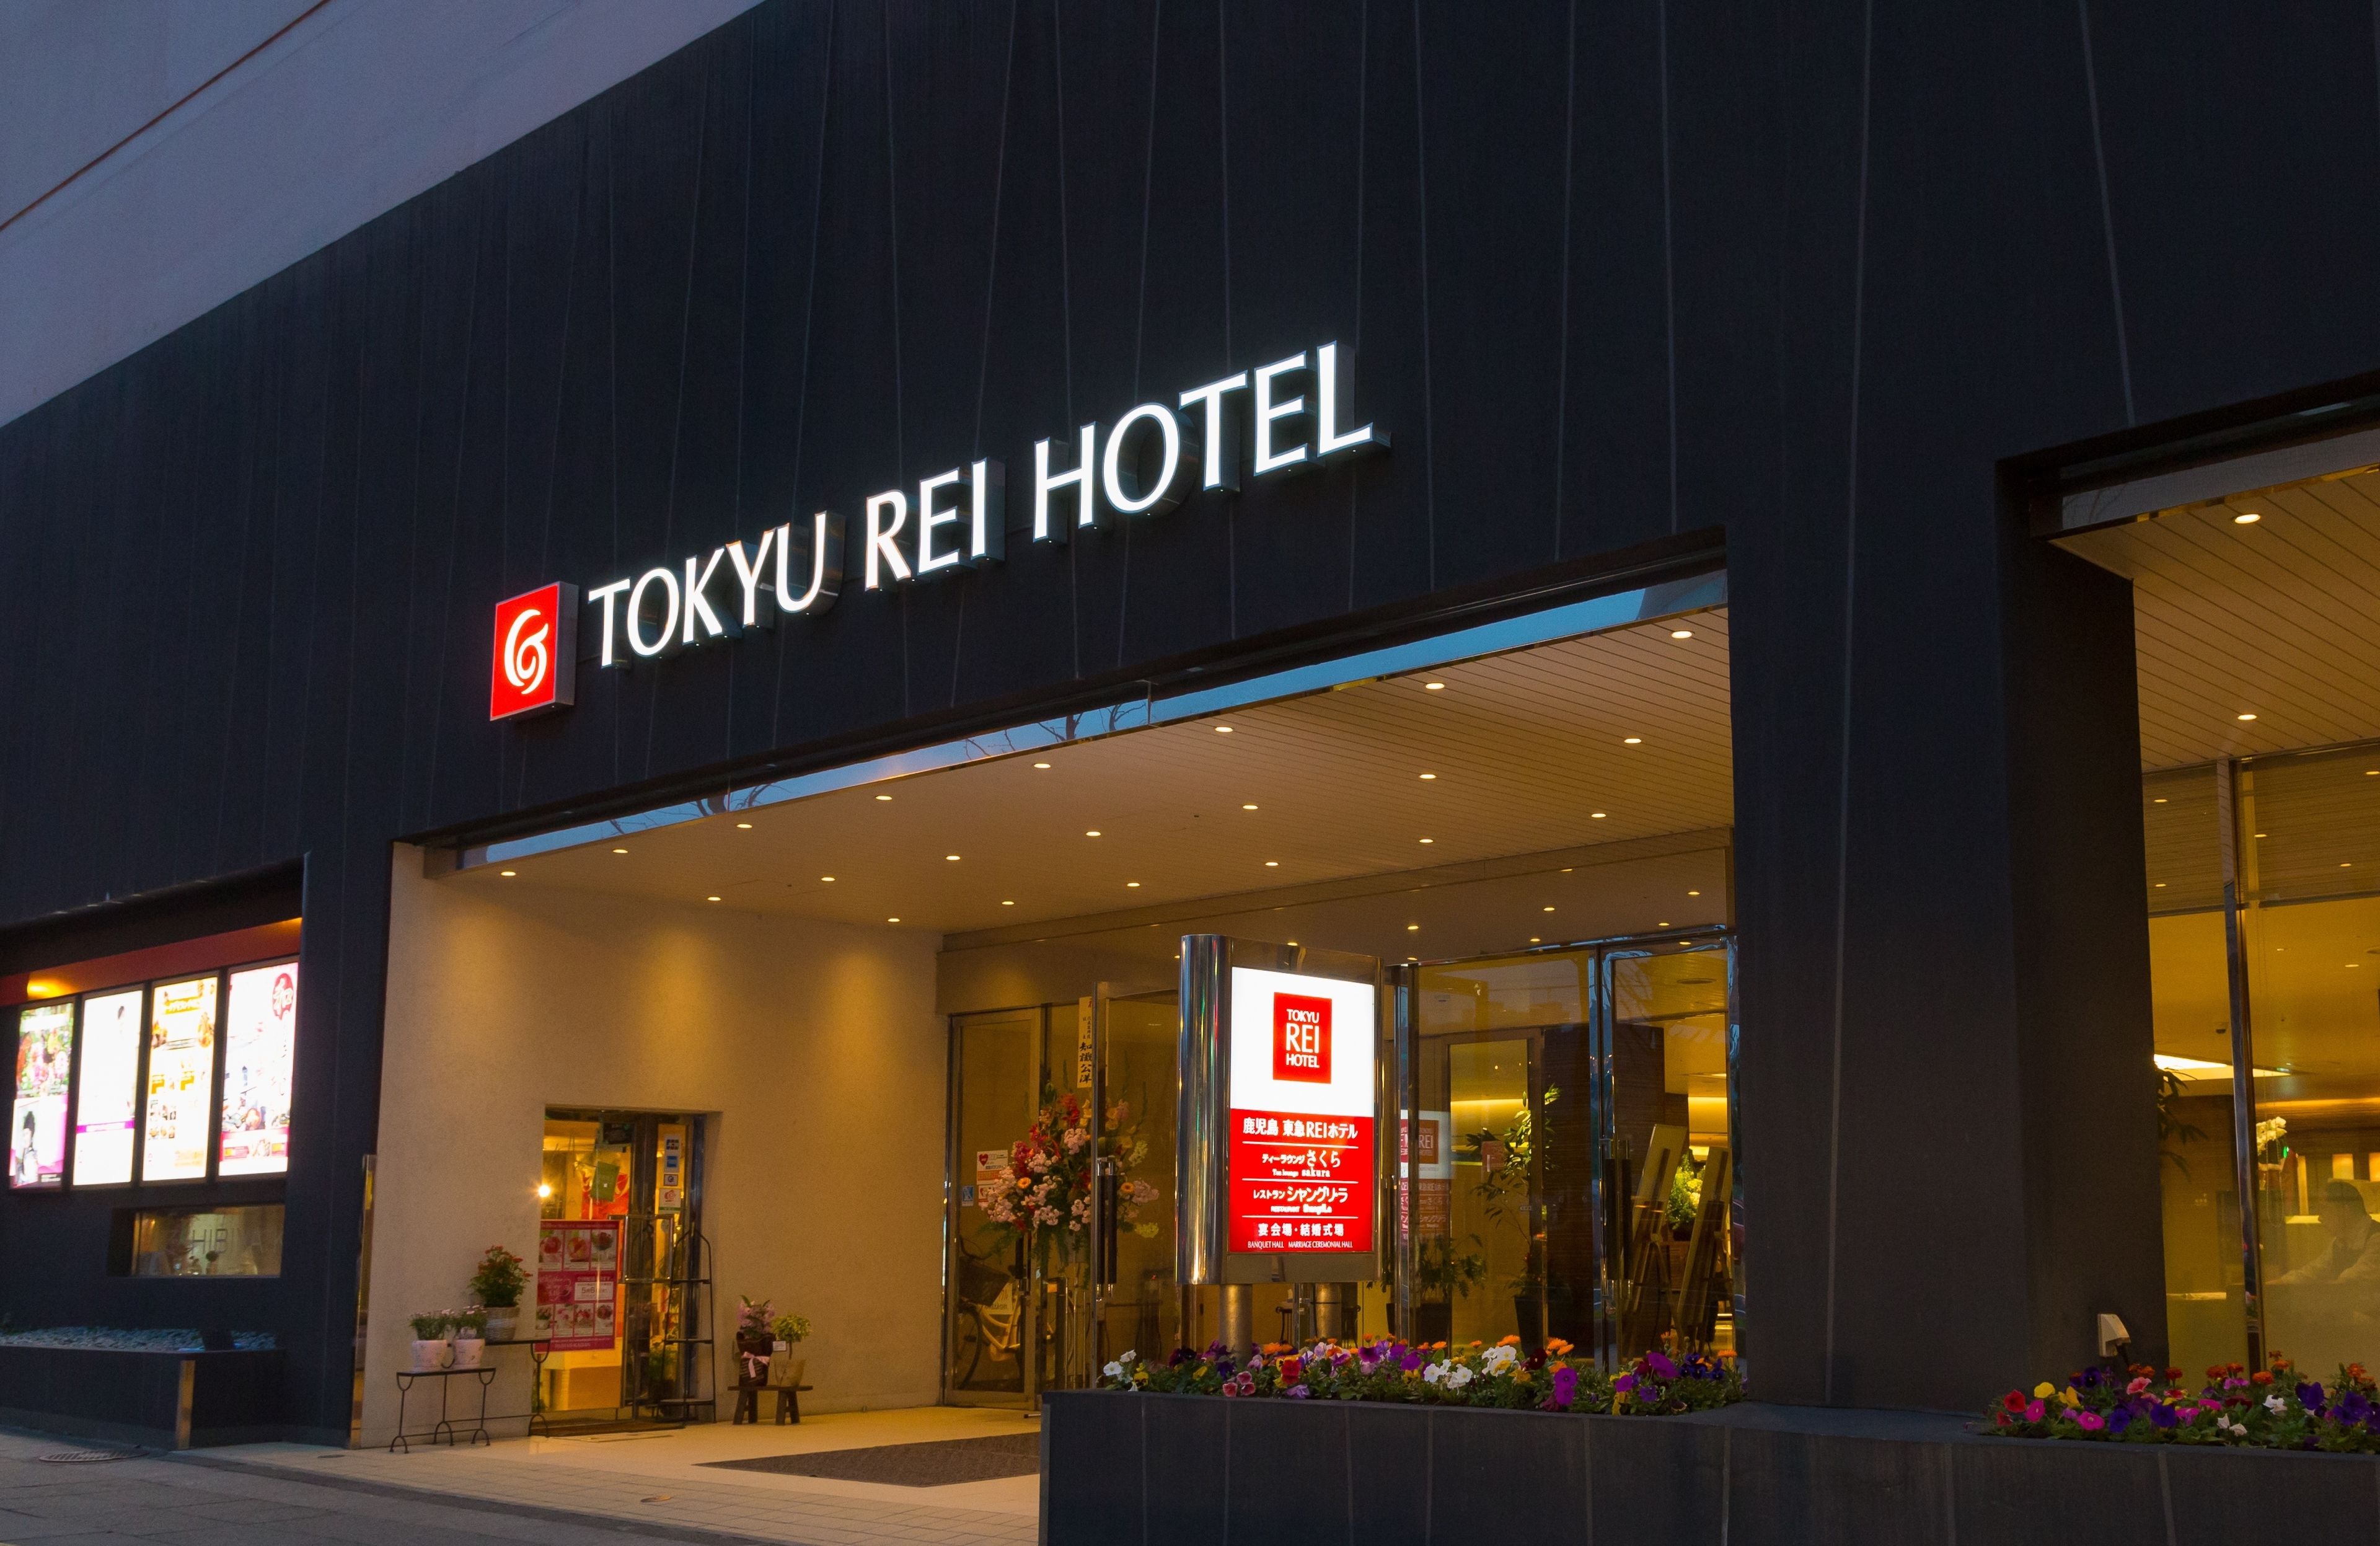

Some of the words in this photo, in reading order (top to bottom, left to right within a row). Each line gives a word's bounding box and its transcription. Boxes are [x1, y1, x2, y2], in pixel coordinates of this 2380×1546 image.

[587, 511, 828, 668] TOKYU
[864, 459, 987, 590] REI
[1033, 341, 1373, 541] HOTEL
[273, 977, 294, 1017] 和
[1286, 1009, 1320, 1023] TOKYU
[1285, 1023, 1320, 1054] REI
[1285, 1053, 1320, 1068] HOTEL
[1243, 1117, 1279, 1136] 鹿児島
[1282, 1119, 1359, 1139] 東急REIホテル
[1306, 1149, 1341, 1168] さくら
[1301, 1167, 1331, 1177] sakura
[1253, 1190, 1286, 1199] レストラン
[1258, 1222, 1344, 1237] 宴会場・結婚式場
[1248, 1241, 1271, 1250] BANQUET
